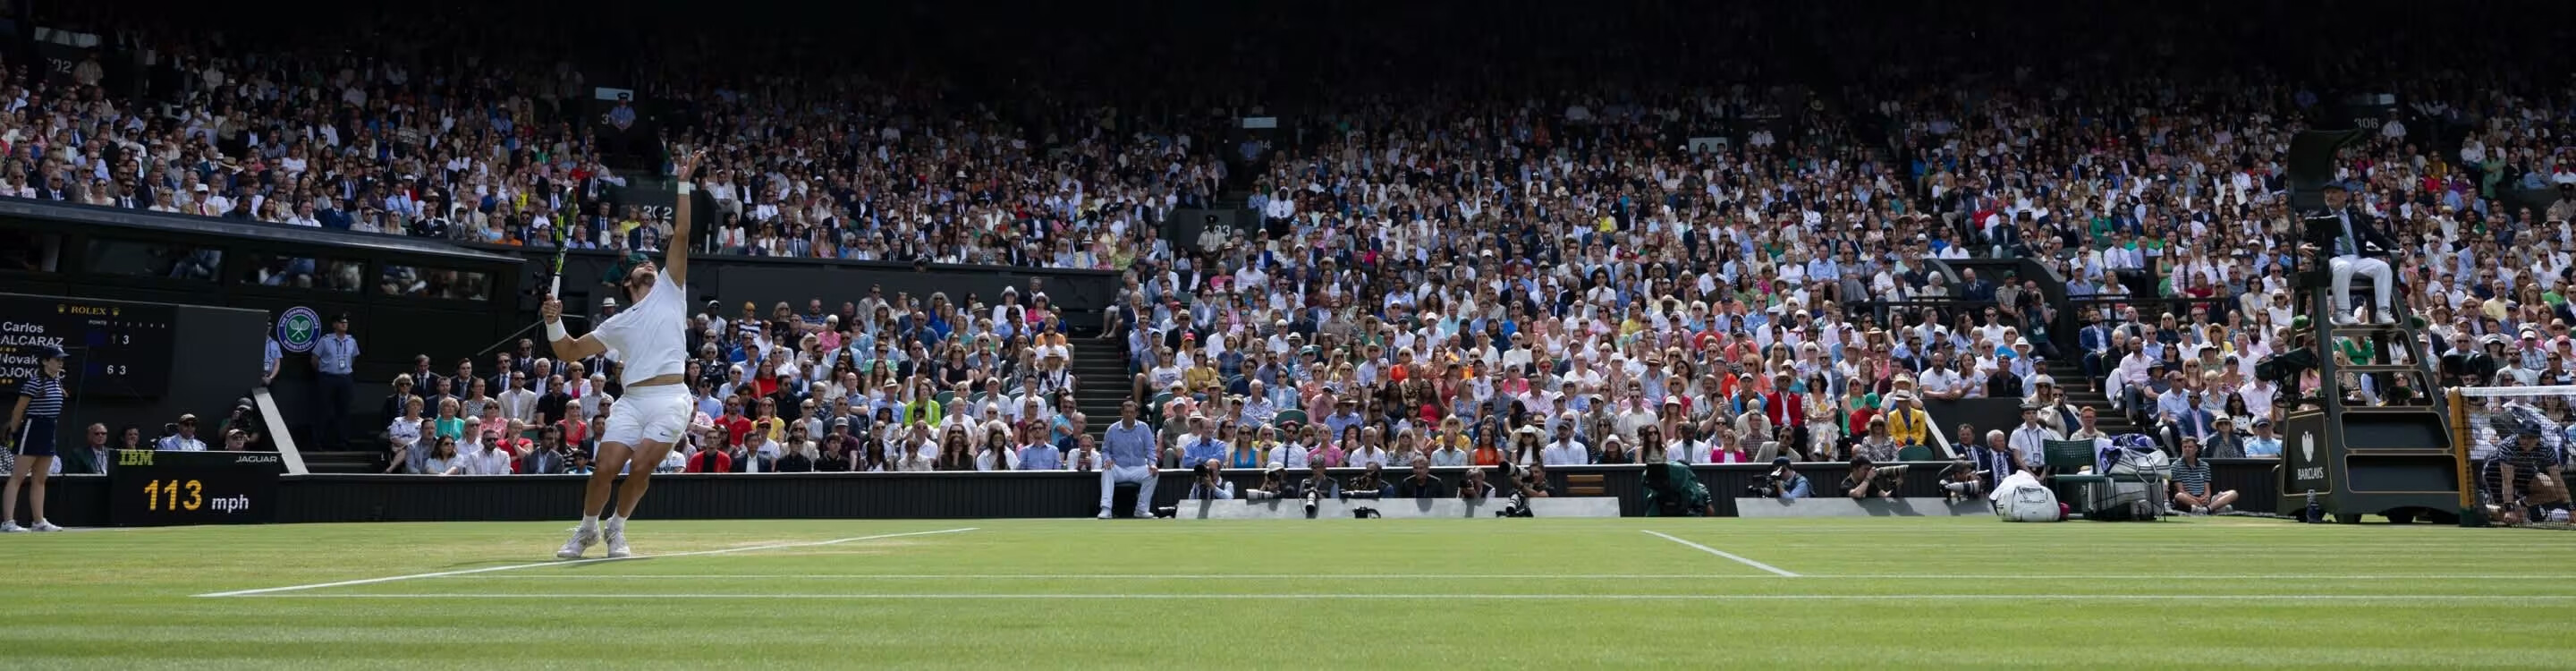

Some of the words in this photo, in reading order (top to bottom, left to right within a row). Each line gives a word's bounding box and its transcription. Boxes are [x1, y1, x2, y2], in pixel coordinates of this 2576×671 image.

[2353, 117, 2379, 129] 306
[71, 306, 106, 315] ROLEX
[3, 321, 44, 333] Carlos
[0, 335, 64, 347] ALCARAZ
[122, 335, 130, 344] 3
[0, 353, 38, 365] Novak
[0, 367, 66, 379] DJOKC
[106, 364, 114, 375] 6
[119, 365, 127, 376] 3
[119, 450, 155, 466] IBM
[235, 455, 278, 463] JAGUAR
[2297, 466, 2324, 480] BARCLAYS
[144, 480, 202, 511] 113
[211, 494, 250, 514] mph
